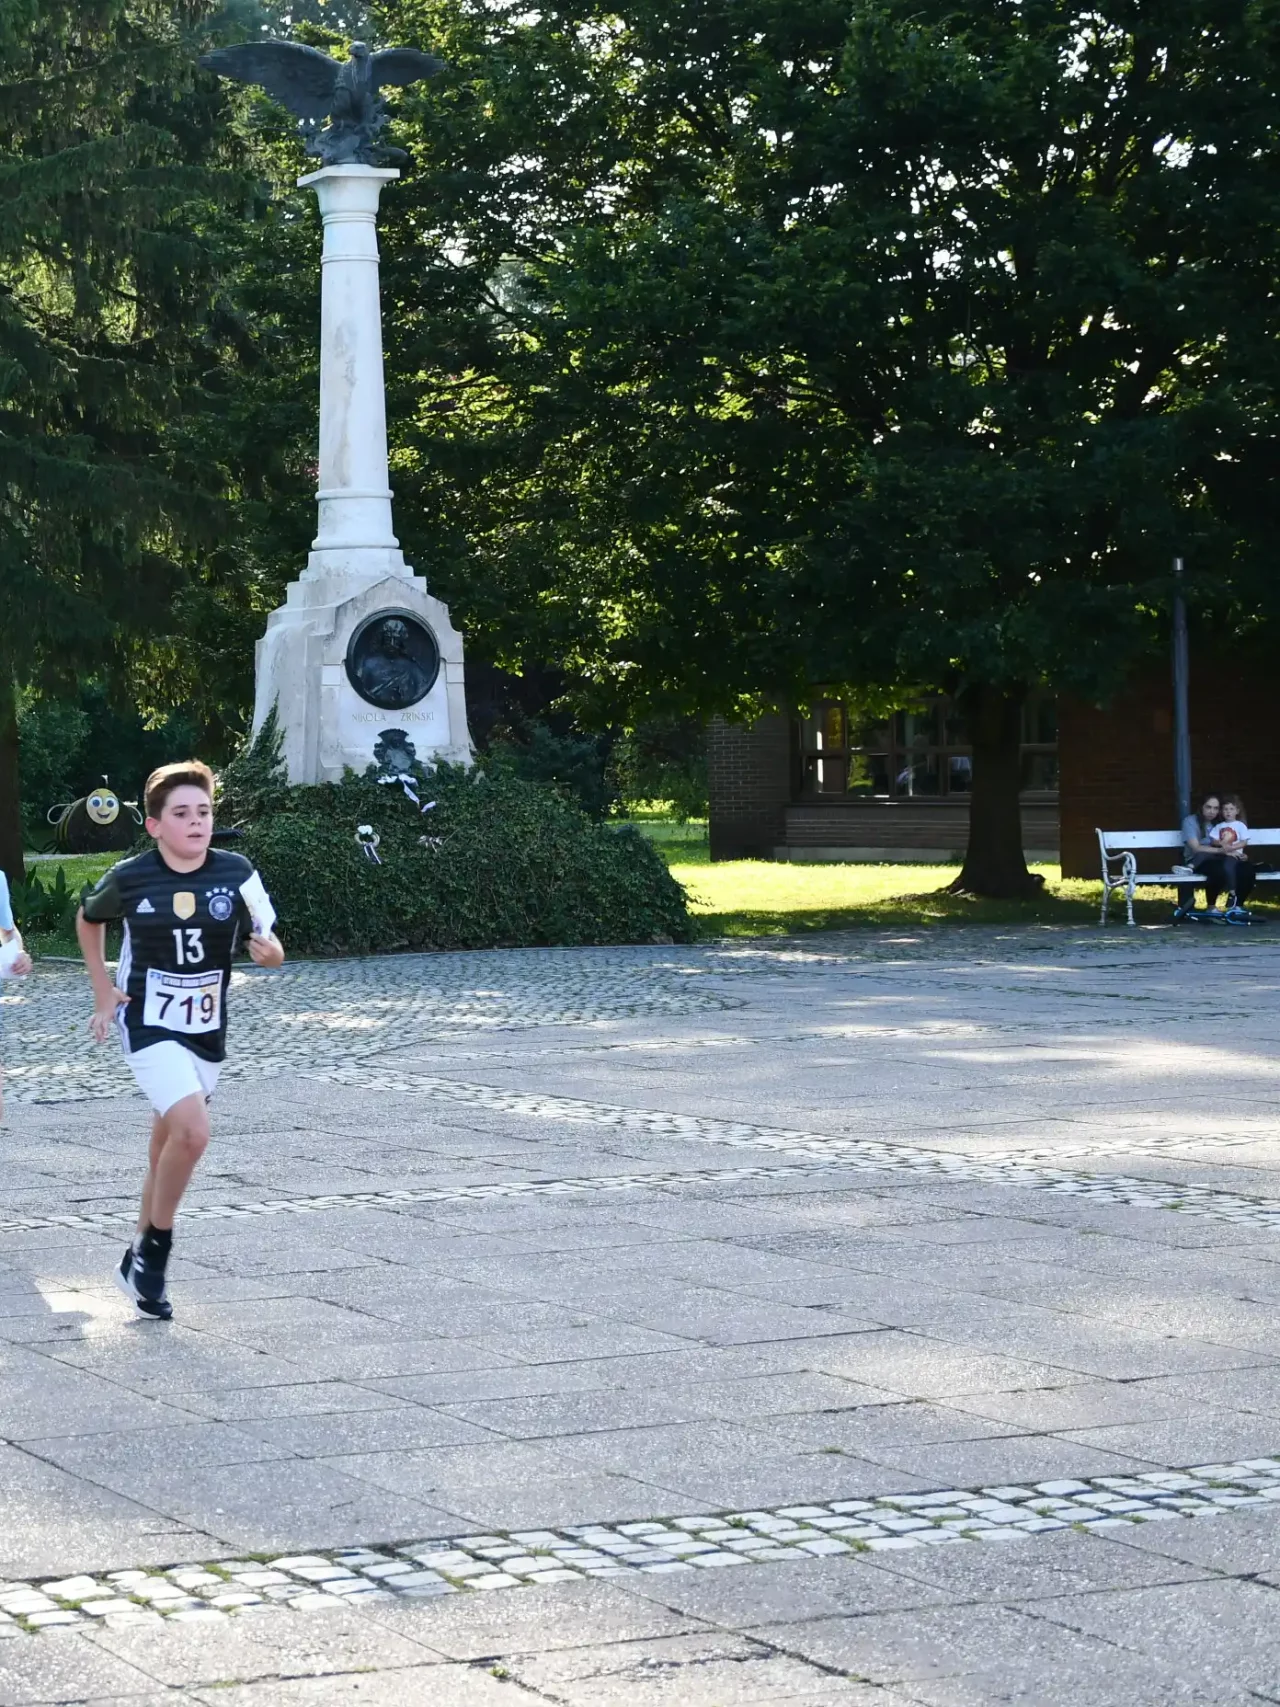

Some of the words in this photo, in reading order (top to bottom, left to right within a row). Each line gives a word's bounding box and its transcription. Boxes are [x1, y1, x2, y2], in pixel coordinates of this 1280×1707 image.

[352, 712, 387, 722] NIKOLA
[400, 712, 434, 721] ZRINSKI
[172, 928, 205, 965] 13
[155, 991, 214, 1025] 719
